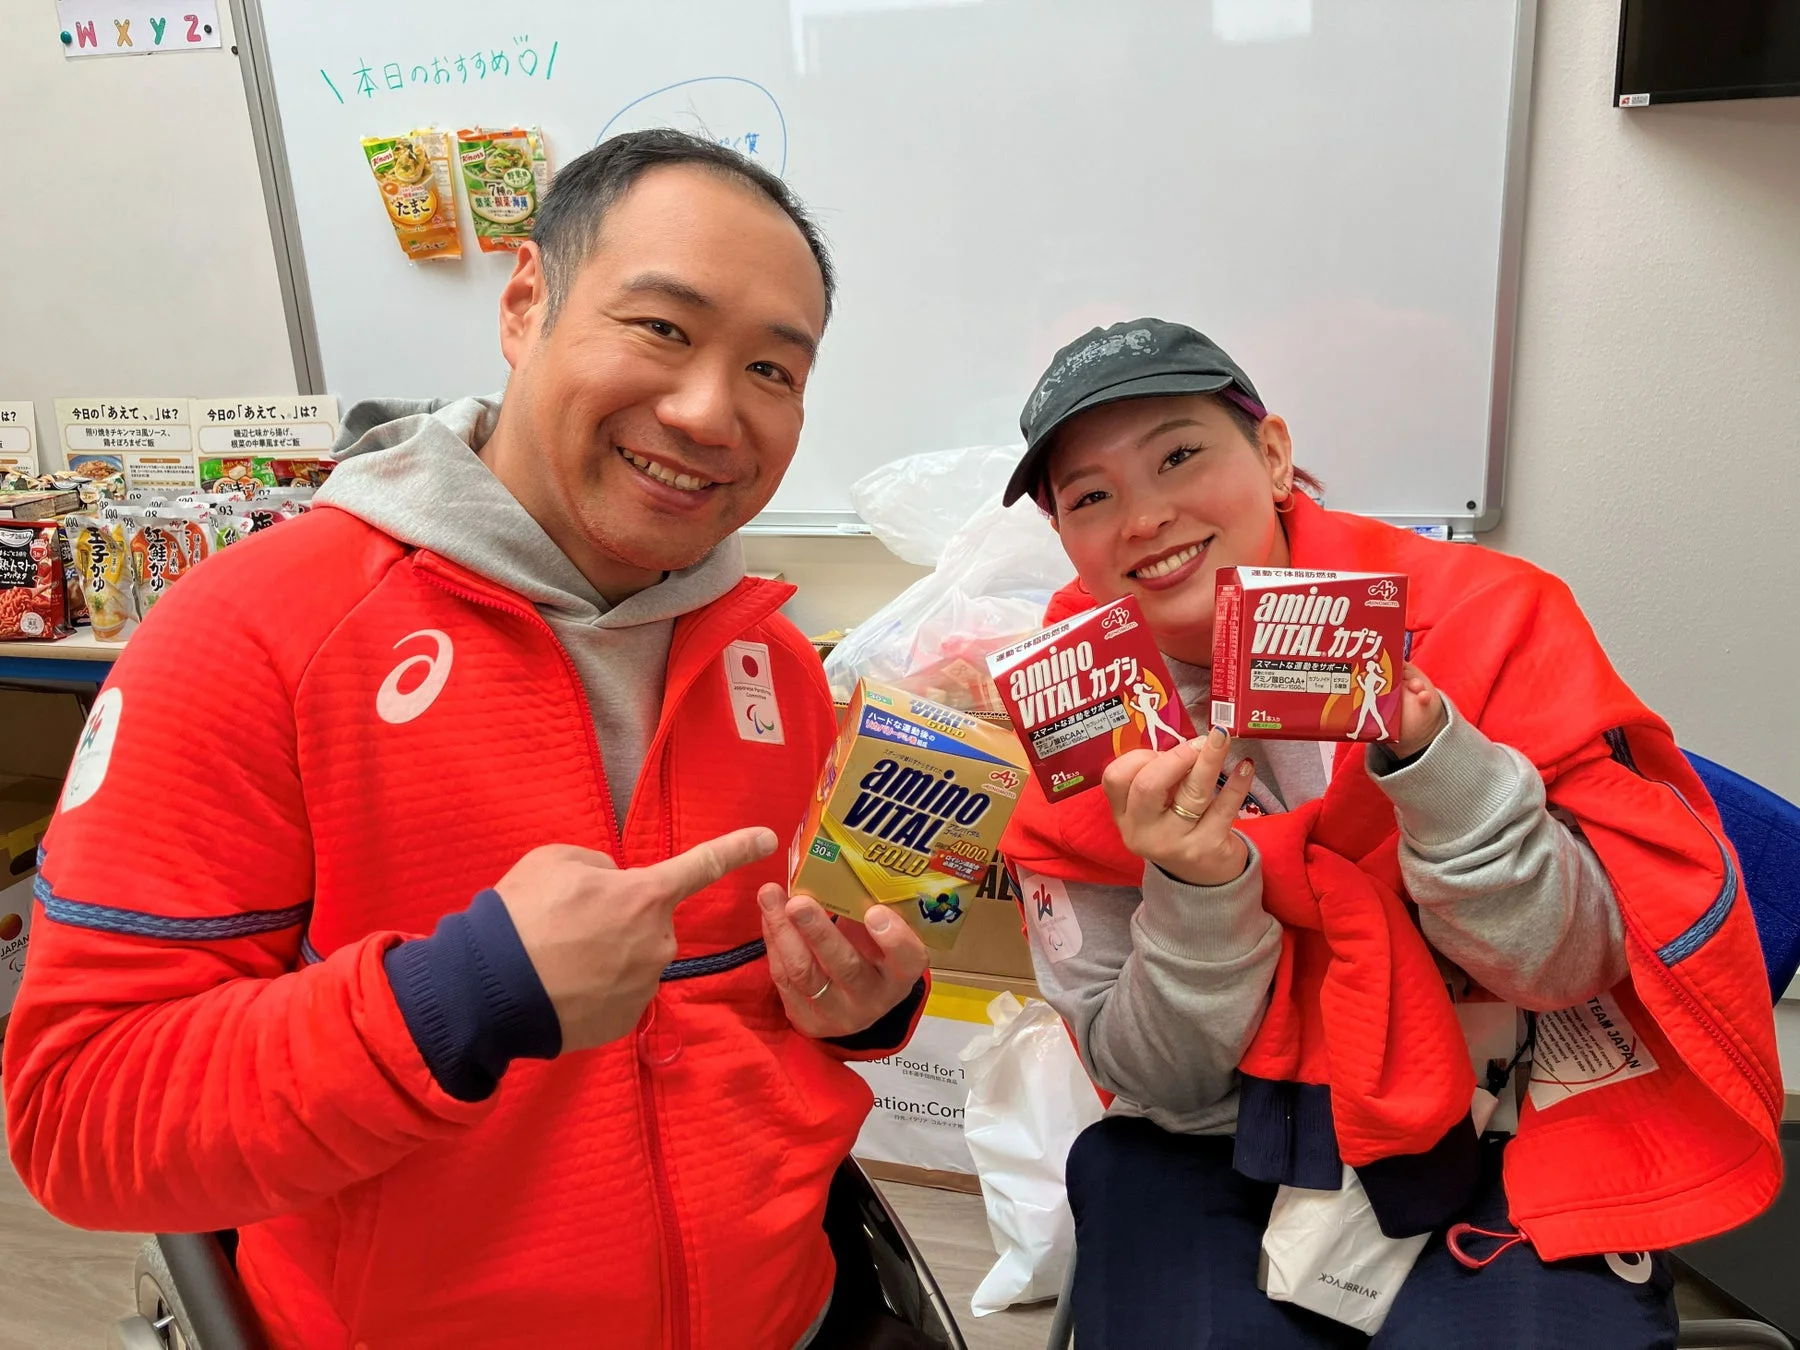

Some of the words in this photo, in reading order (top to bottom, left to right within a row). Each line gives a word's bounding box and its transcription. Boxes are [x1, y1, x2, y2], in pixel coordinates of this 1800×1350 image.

[76, 20, 97, 48] W
[114, 18, 133, 47] X
[150, 17, 166, 45] Y
[183, 14, 202, 42] Z
[352, 49, 511, 99] 本日のおすすめ
[395, 194, 431, 217] たまご
[219, 505, 233, 516] 93
[86, 526, 110, 592] 玉子がゆ
[144, 526, 168, 592] 紅鮭がゆ
[1251, 569, 1338, 580] 運動で体脂肪燃焼
[1253, 586, 1350, 626] amino
[995, 623, 1070, 663] 運動で体脂肪燃焼
[1251, 623, 1325, 658] VITAL
[1328, 627, 1383, 660] カプシ
[1009, 640, 1094, 702] amino
[1255, 660, 1349, 672] スマートな運動をサポート
[1017, 675, 1088, 730] VITAL
[1088, 656, 1138, 700] カプシ
[868, 712, 936, 742] ハードな運動後の
[926, 719, 966, 739] GOLD
[1033, 698, 1119, 740] スマートな運動をサポート
[859, 757, 992, 826] amino
[842, 791, 947, 856] VITAL
[863, 841, 931, 878] GOLD
[950, 840, 989, 862] 4000
[1587, 997, 1614, 1030] TEAM
[1608, 1030, 1641, 1069] JAPAN
[895, 1057, 929, 1073] Food
[933, 1064, 955, 1077] for
